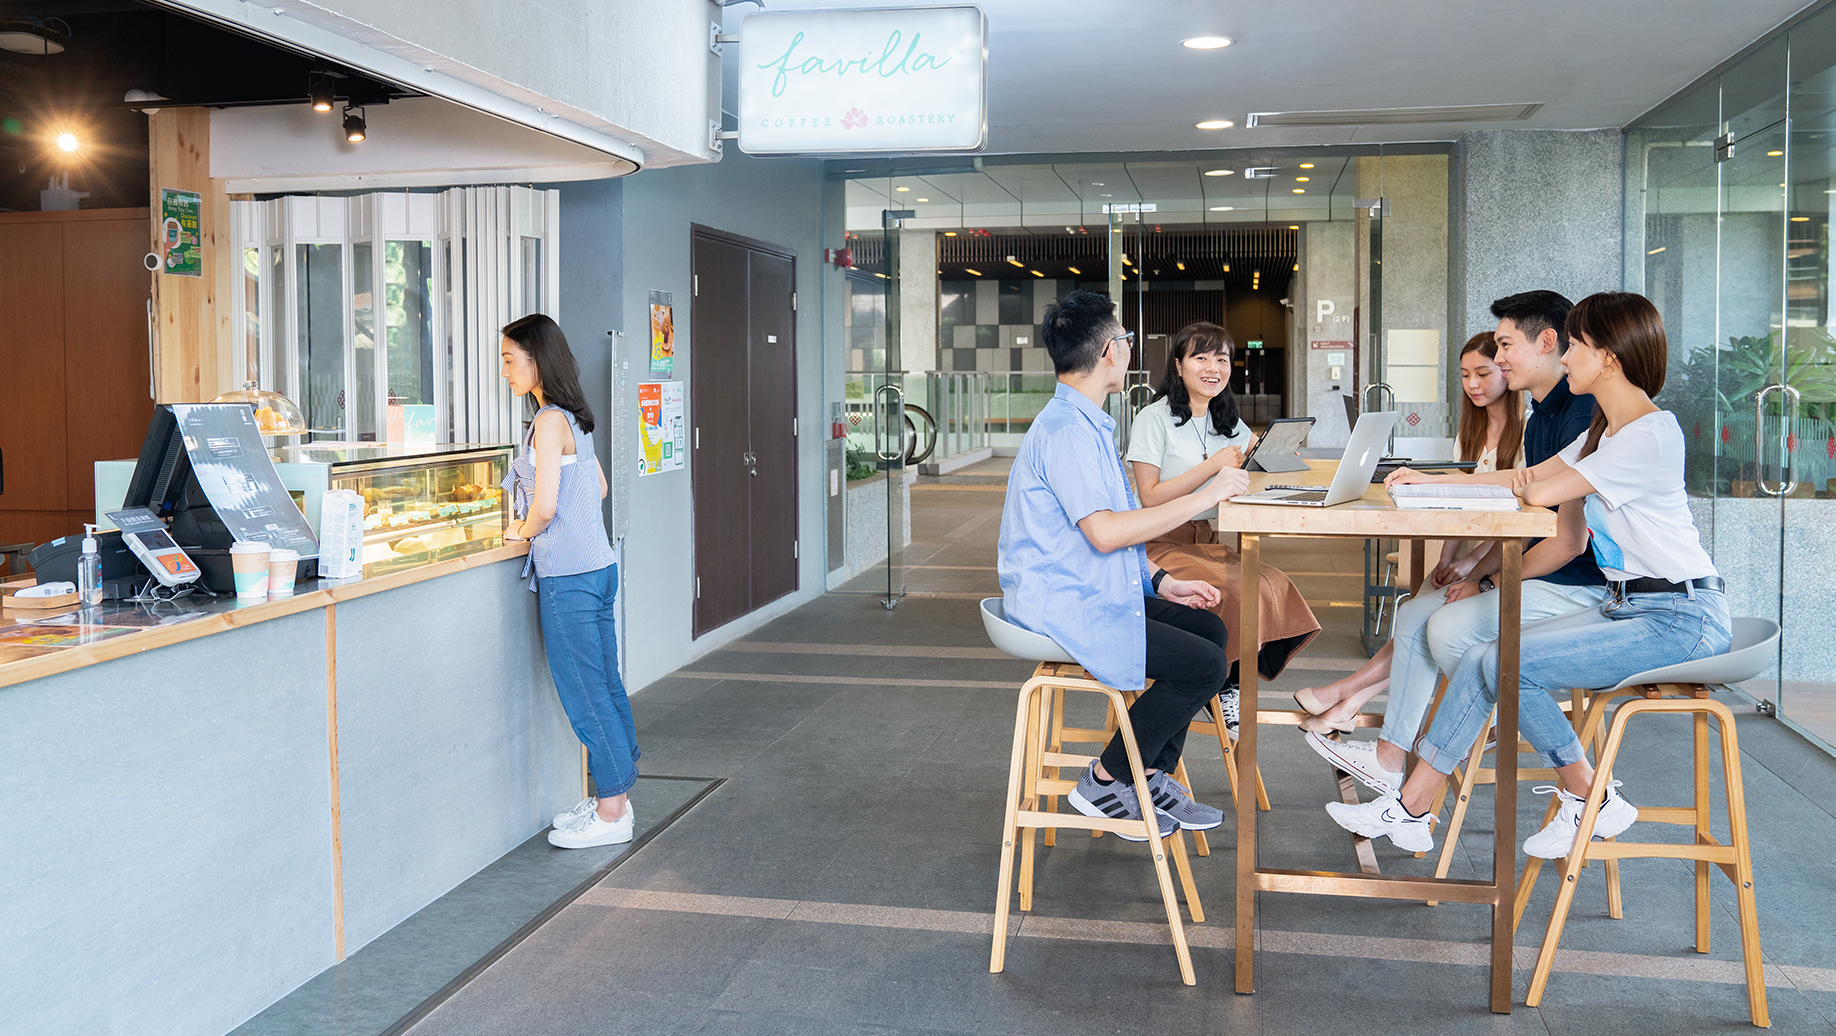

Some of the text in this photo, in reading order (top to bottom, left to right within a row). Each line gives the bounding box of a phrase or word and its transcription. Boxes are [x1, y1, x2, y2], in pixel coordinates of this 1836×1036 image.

[757, 29, 952, 98] favilla
[761, 113, 956, 128] COFFEE ROASTERY
[1317, 300, 1335, 323] P
[1333, 315, 1350, 323] (2/F)
